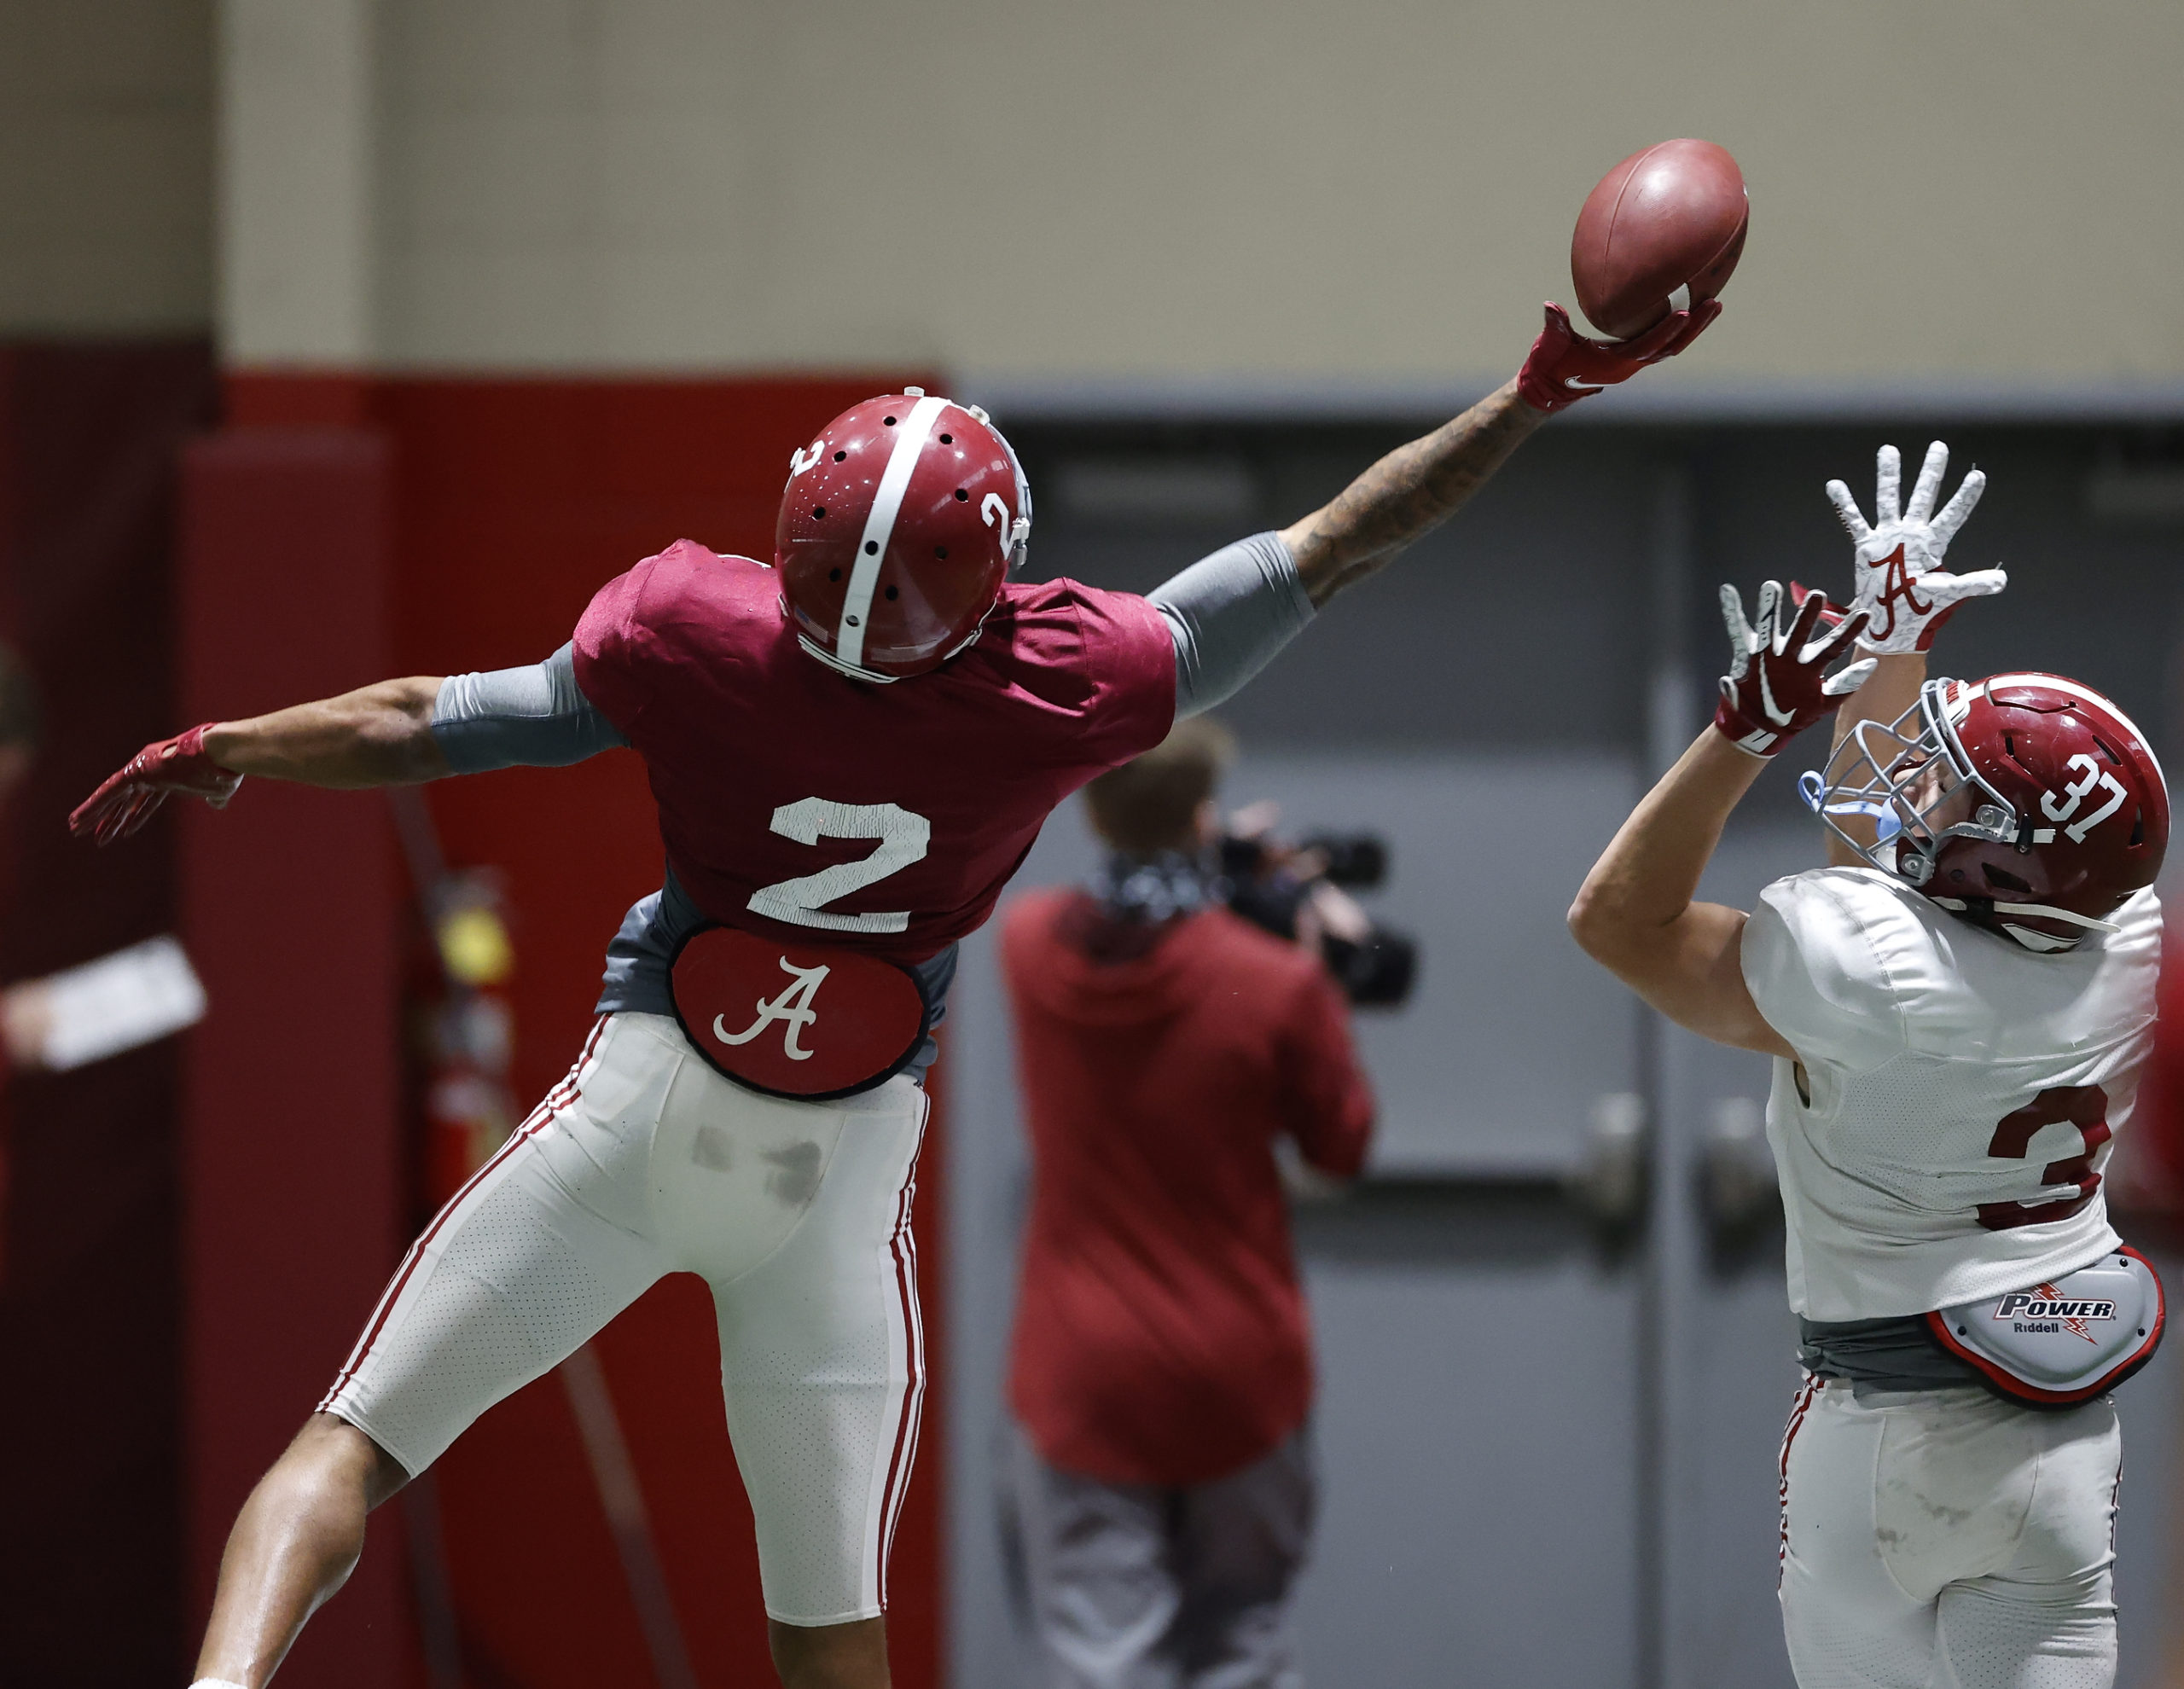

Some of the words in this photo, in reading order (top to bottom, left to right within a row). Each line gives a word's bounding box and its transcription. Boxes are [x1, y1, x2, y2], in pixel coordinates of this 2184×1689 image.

[980, 492, 1017, 560] 2
[1867, 542, 1934, 641] A
[2040, 753, 2129, 844] 37
[745, 796, 931, 934] 2
[712, 955, 831, 1061] A
[1974, 1082, 2112, 1232] 3
[1995, 1293, 2114, 1319] POWER
[2013, 1322, 2059, 1333] Riddell
